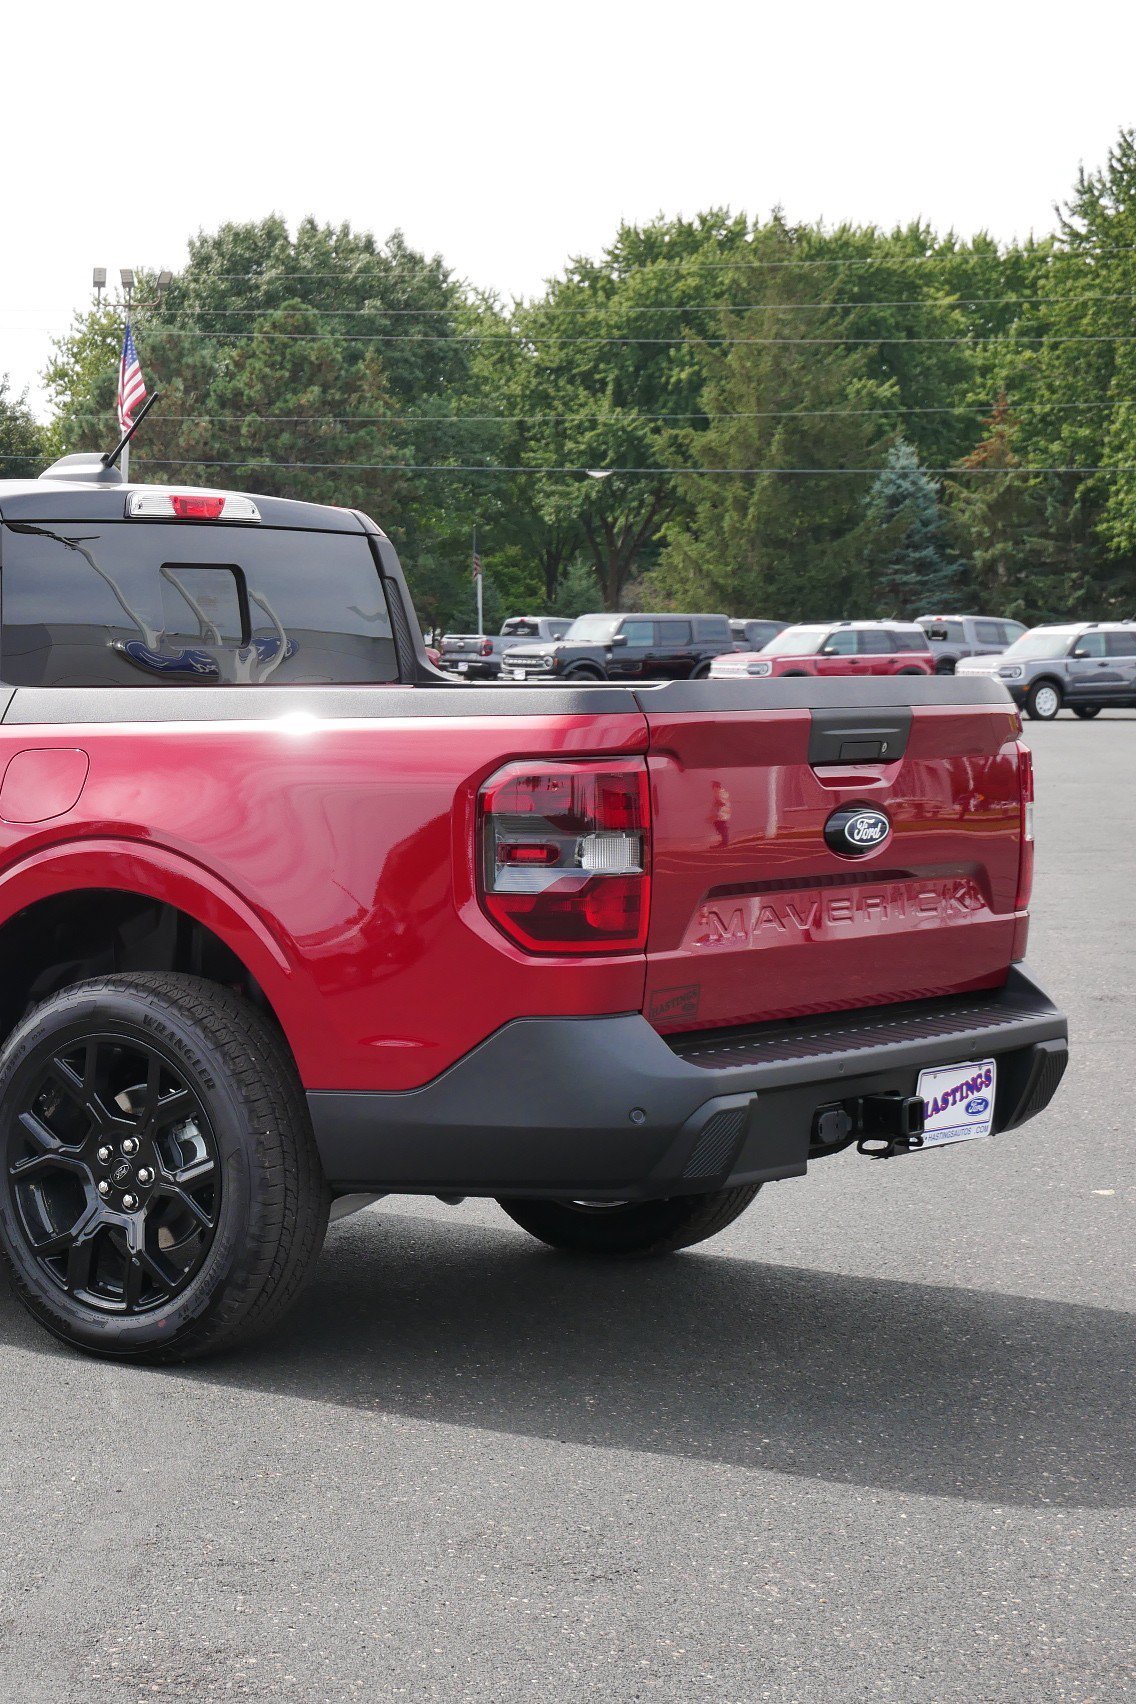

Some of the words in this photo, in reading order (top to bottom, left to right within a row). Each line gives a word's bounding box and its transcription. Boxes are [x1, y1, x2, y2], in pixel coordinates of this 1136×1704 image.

[854, 818, 882, 840] Ford
[709, 887, 971, 939] MAVERICK
[144, 1014, 216, 1091] WRANGLER
